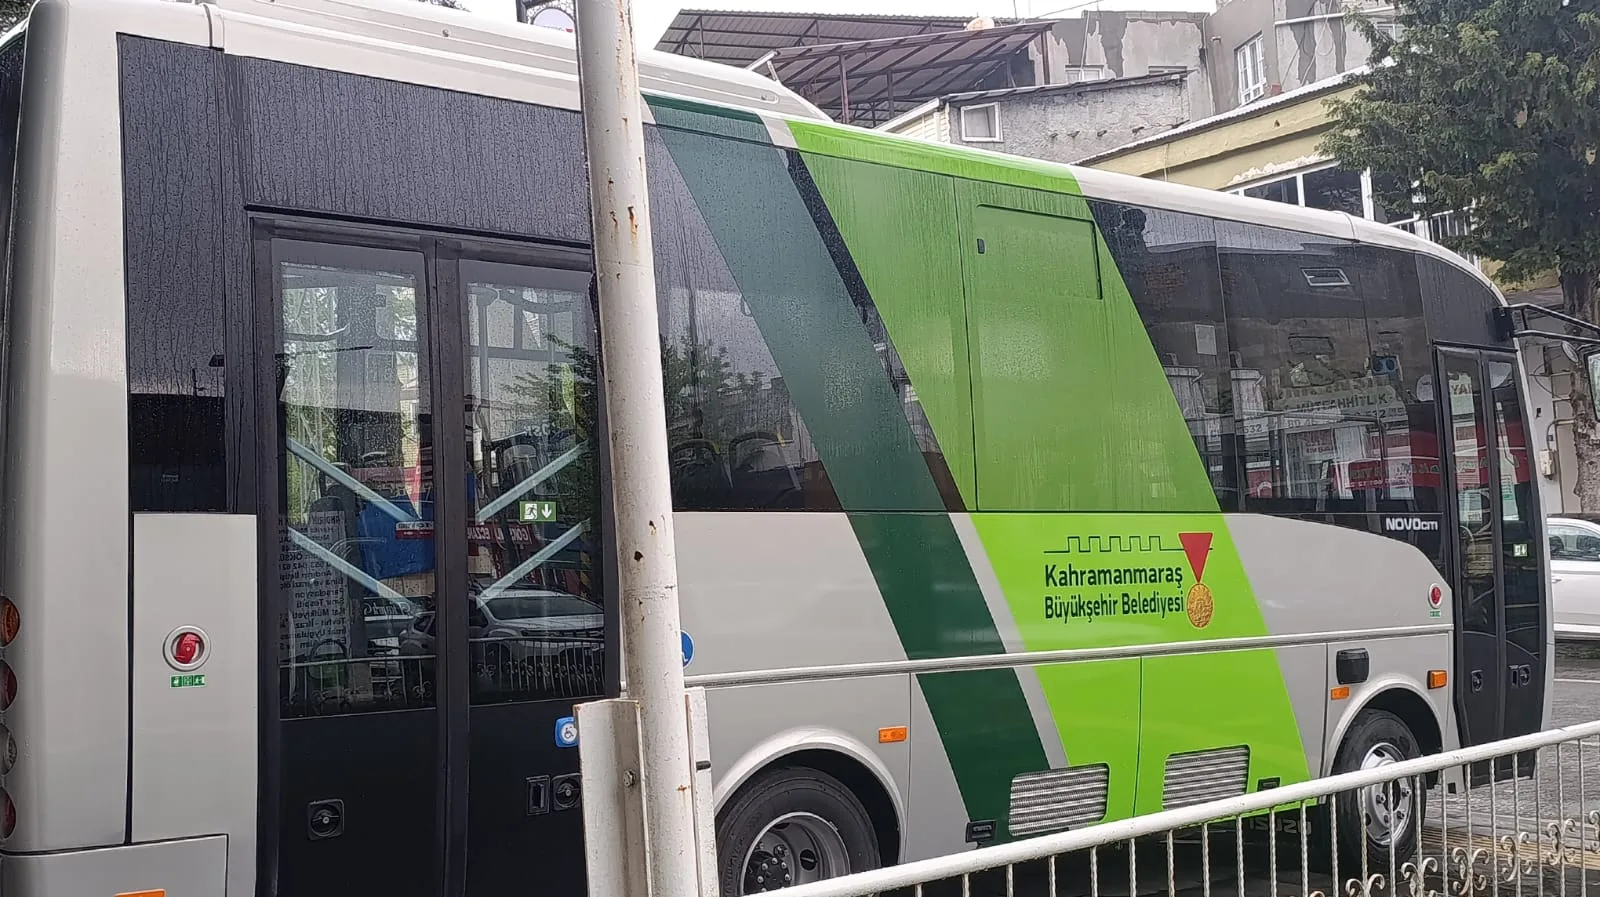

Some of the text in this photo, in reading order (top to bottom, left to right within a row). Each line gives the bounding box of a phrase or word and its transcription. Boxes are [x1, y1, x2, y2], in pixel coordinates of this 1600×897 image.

[1045, 564, 1183, 588] Kahramanmaraş
[1045, 591, 1184, 624] Büyükşehir Belediyesi
